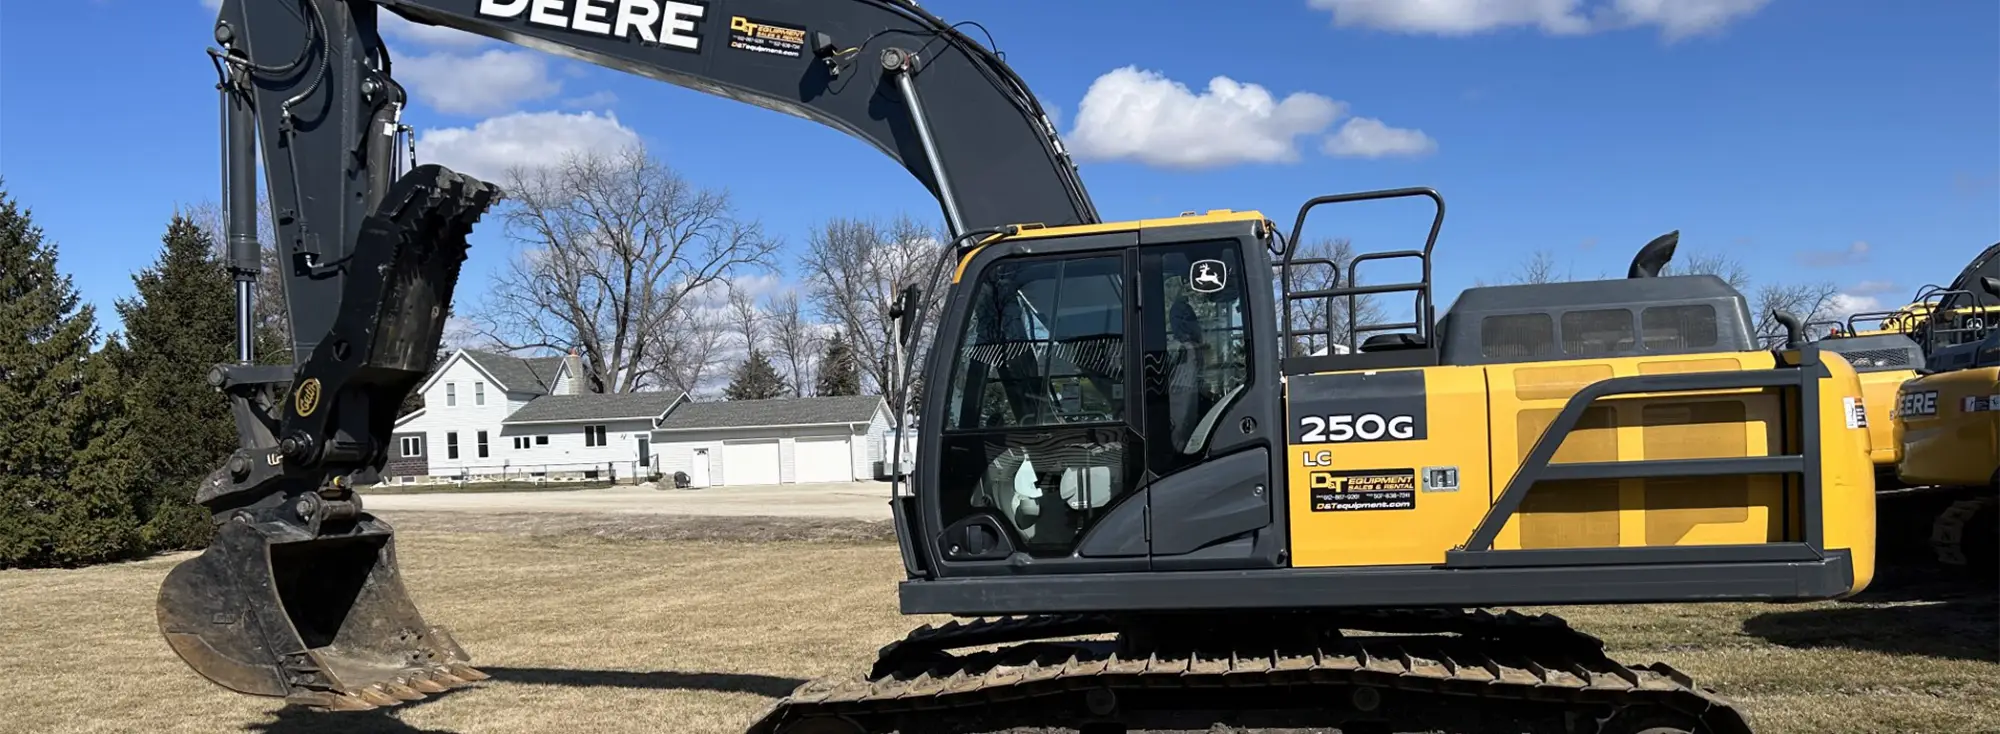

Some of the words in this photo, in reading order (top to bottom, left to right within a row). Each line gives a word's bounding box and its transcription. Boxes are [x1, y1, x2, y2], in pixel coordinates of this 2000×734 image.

[757, 25, 806, 37] EQUIPMENT
[1301, 413, 1414, 442] 250G
[1303, 451, 1331, 466] LC
[1310, 472, 1347, 493] D&T
[1348, 476, 1413, 485] EQUIPMENT
[1316, 502, 1411, 510] D&Tequipment.com
